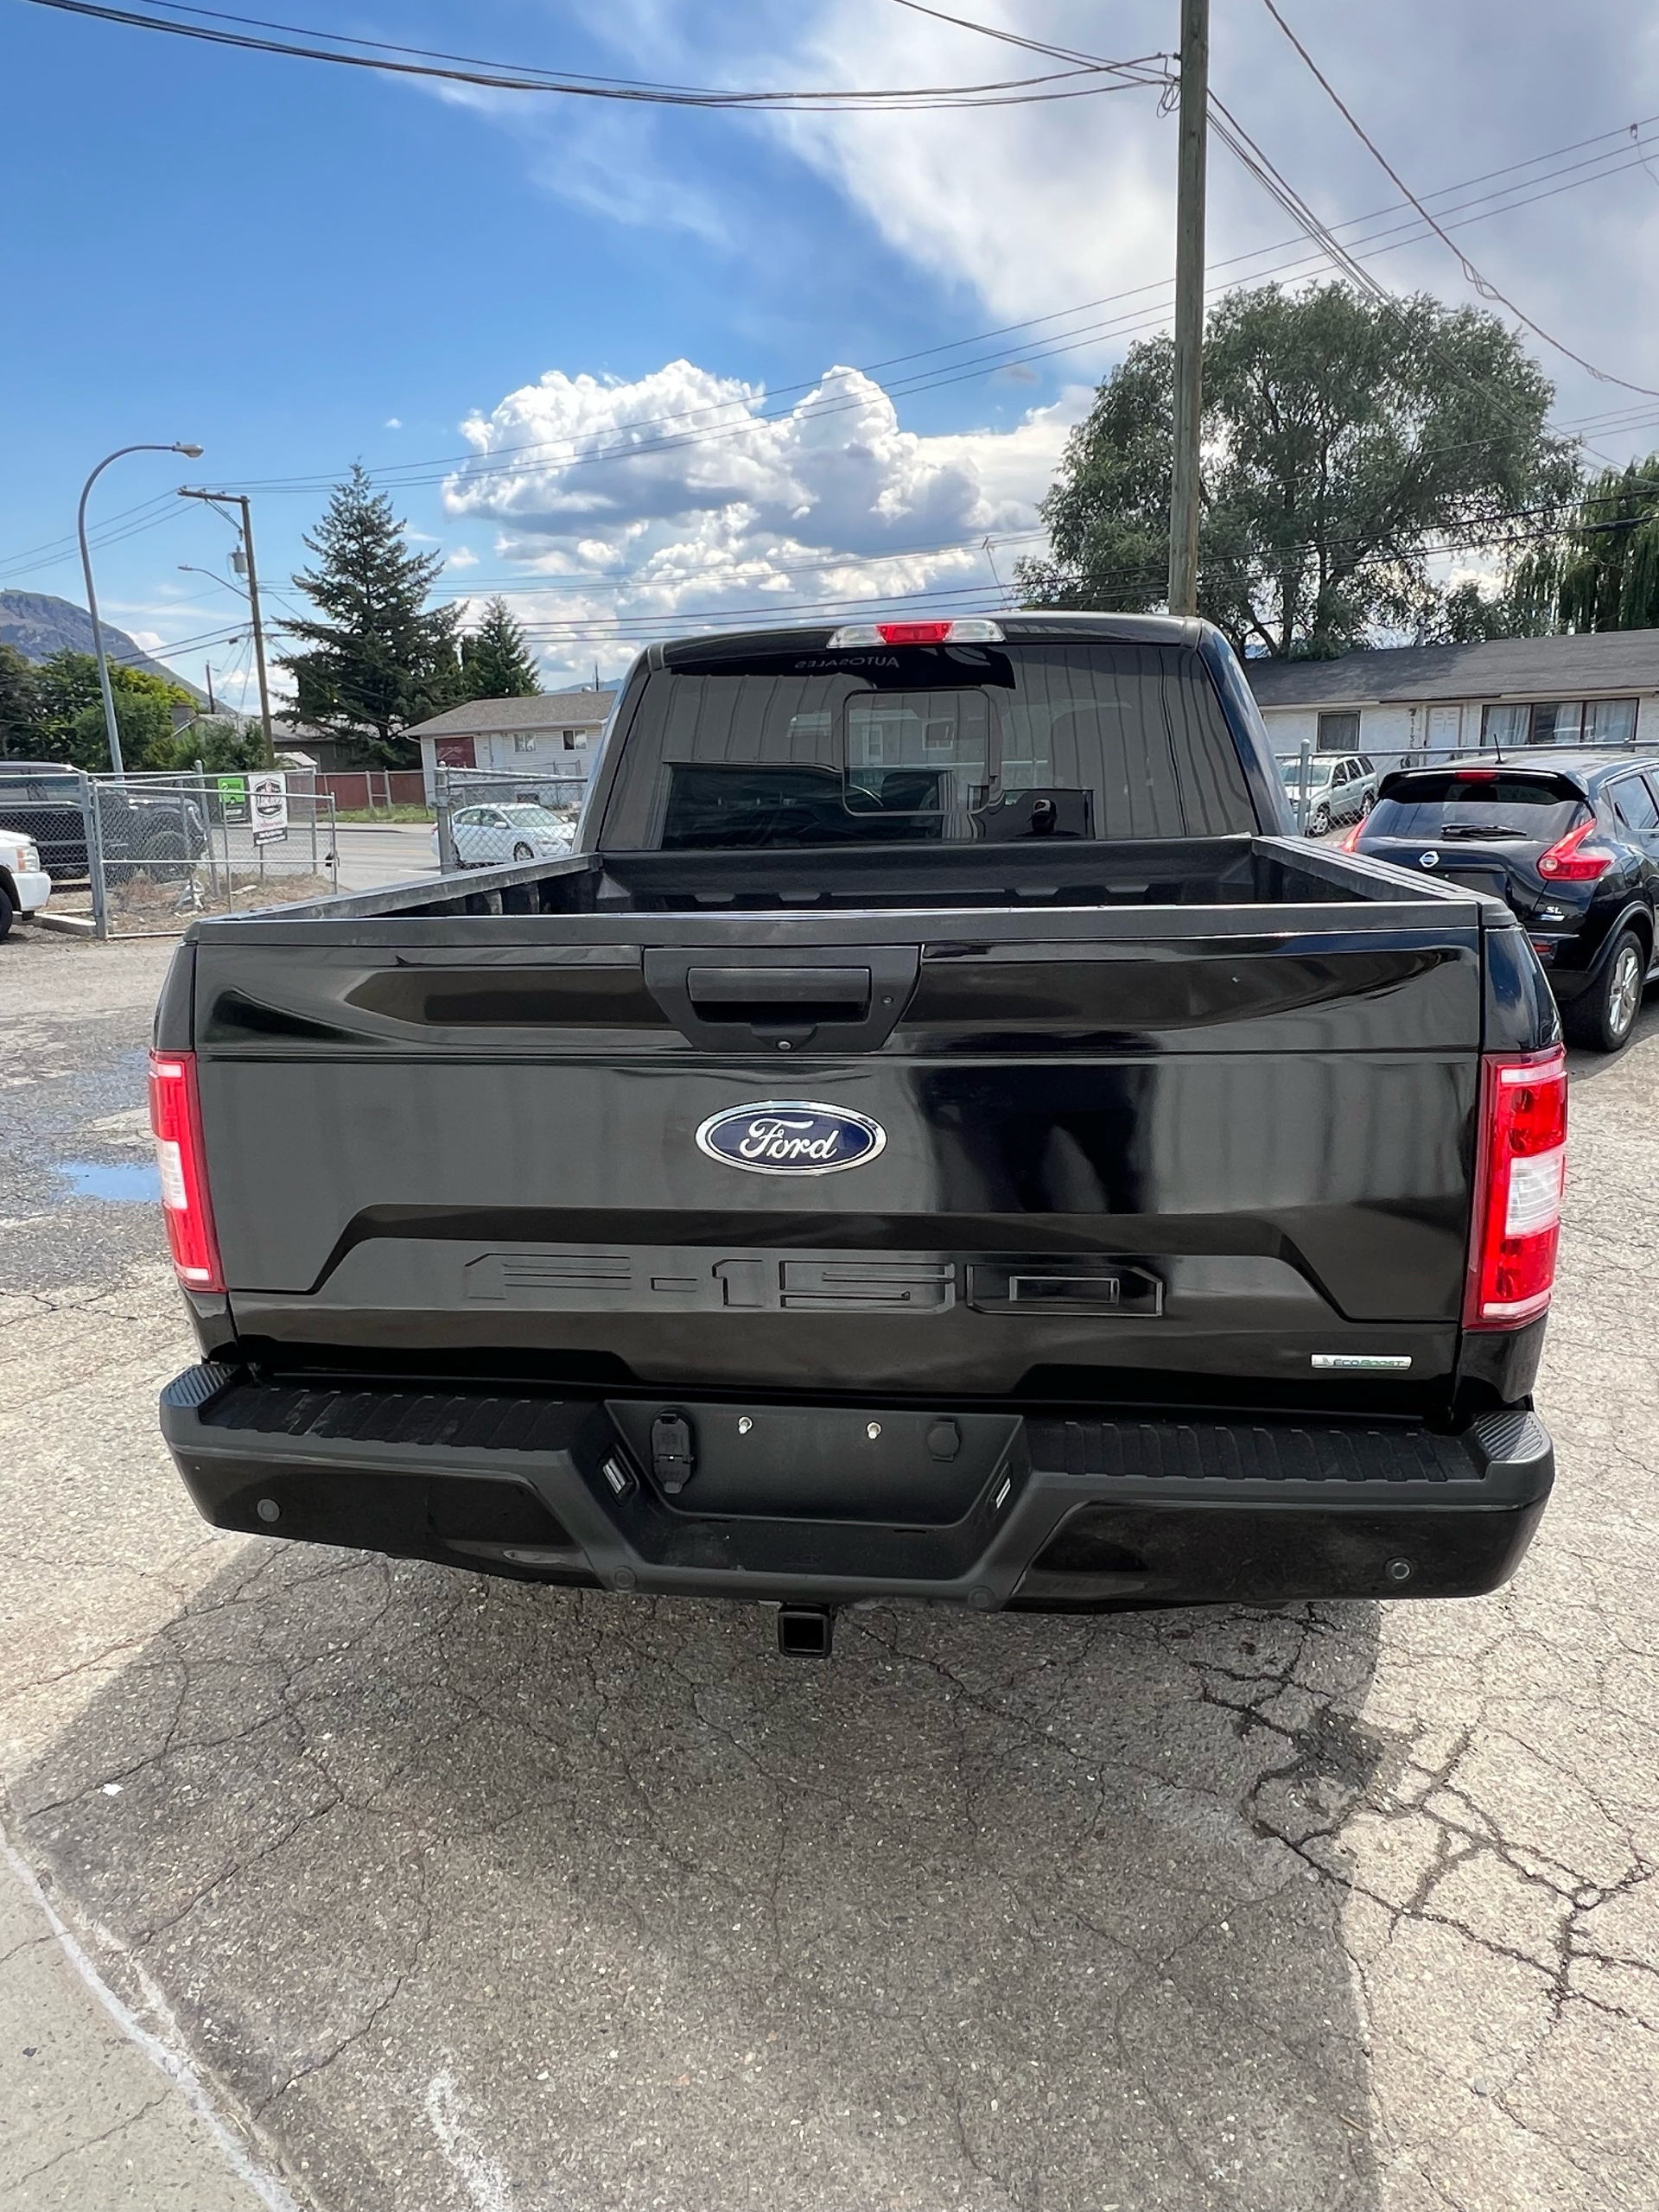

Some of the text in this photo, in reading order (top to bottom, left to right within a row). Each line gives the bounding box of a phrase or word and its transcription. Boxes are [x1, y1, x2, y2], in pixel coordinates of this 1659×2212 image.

[1546, 906, 1562, 914] SL
[739, 1117, 840, 1160] Ford
[464, 1252, 1164, 1317] F-150
